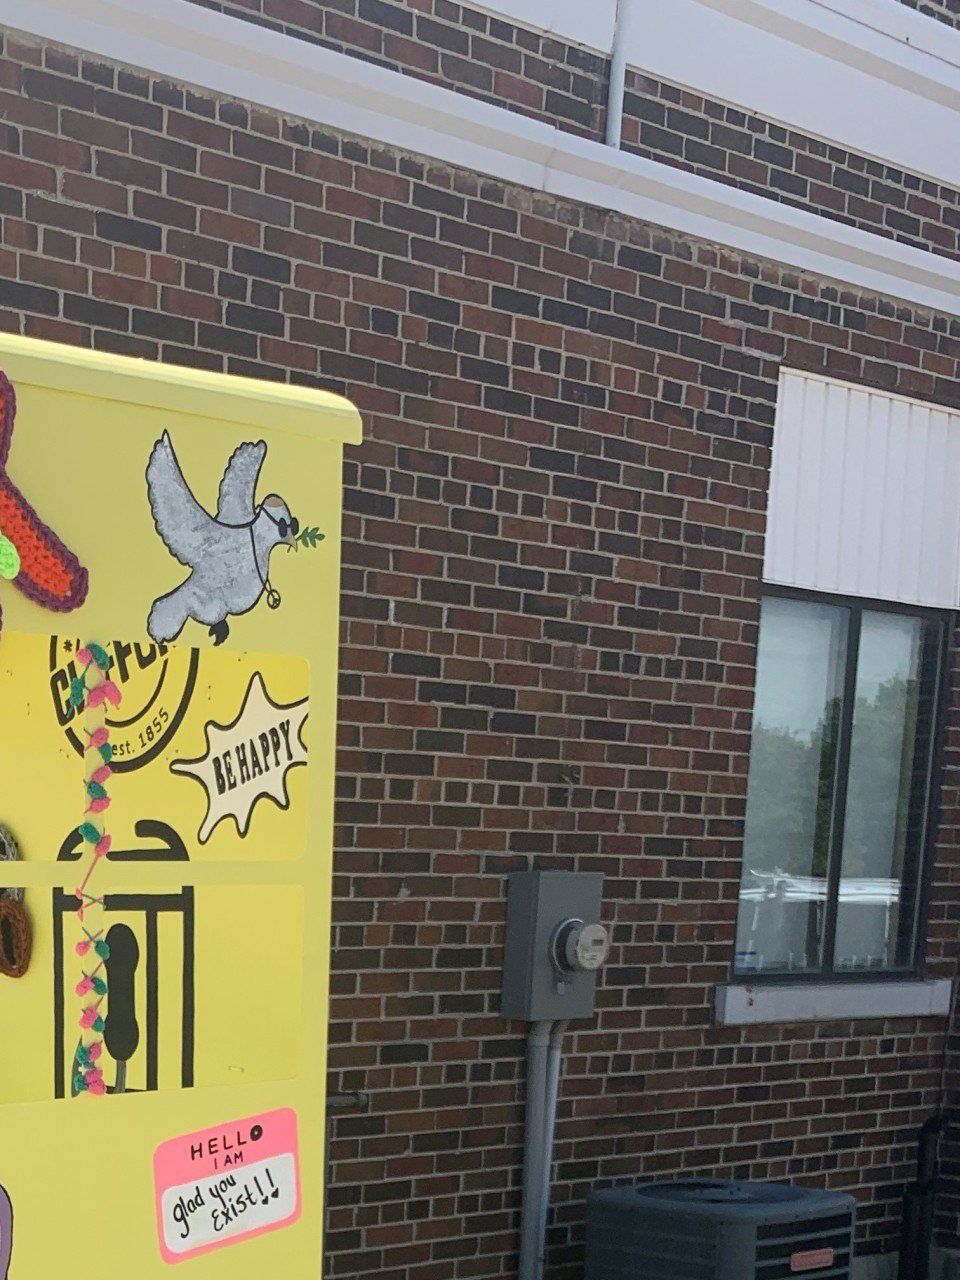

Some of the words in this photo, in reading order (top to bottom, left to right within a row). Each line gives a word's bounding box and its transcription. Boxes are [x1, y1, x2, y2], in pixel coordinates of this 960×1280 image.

[138, 707, 169, 749] 1855
[212, 750, 237, 795] BE
[235, 718, 293, 785] HAPPY
[190, 1124, 263, 1161] HELLO
[213, 1157, 219, 1170] I
[223, 1151, 244, 1167] AM
[172, 1185, 206, 1239] glad
[208, 1174, 237, 1210] you
